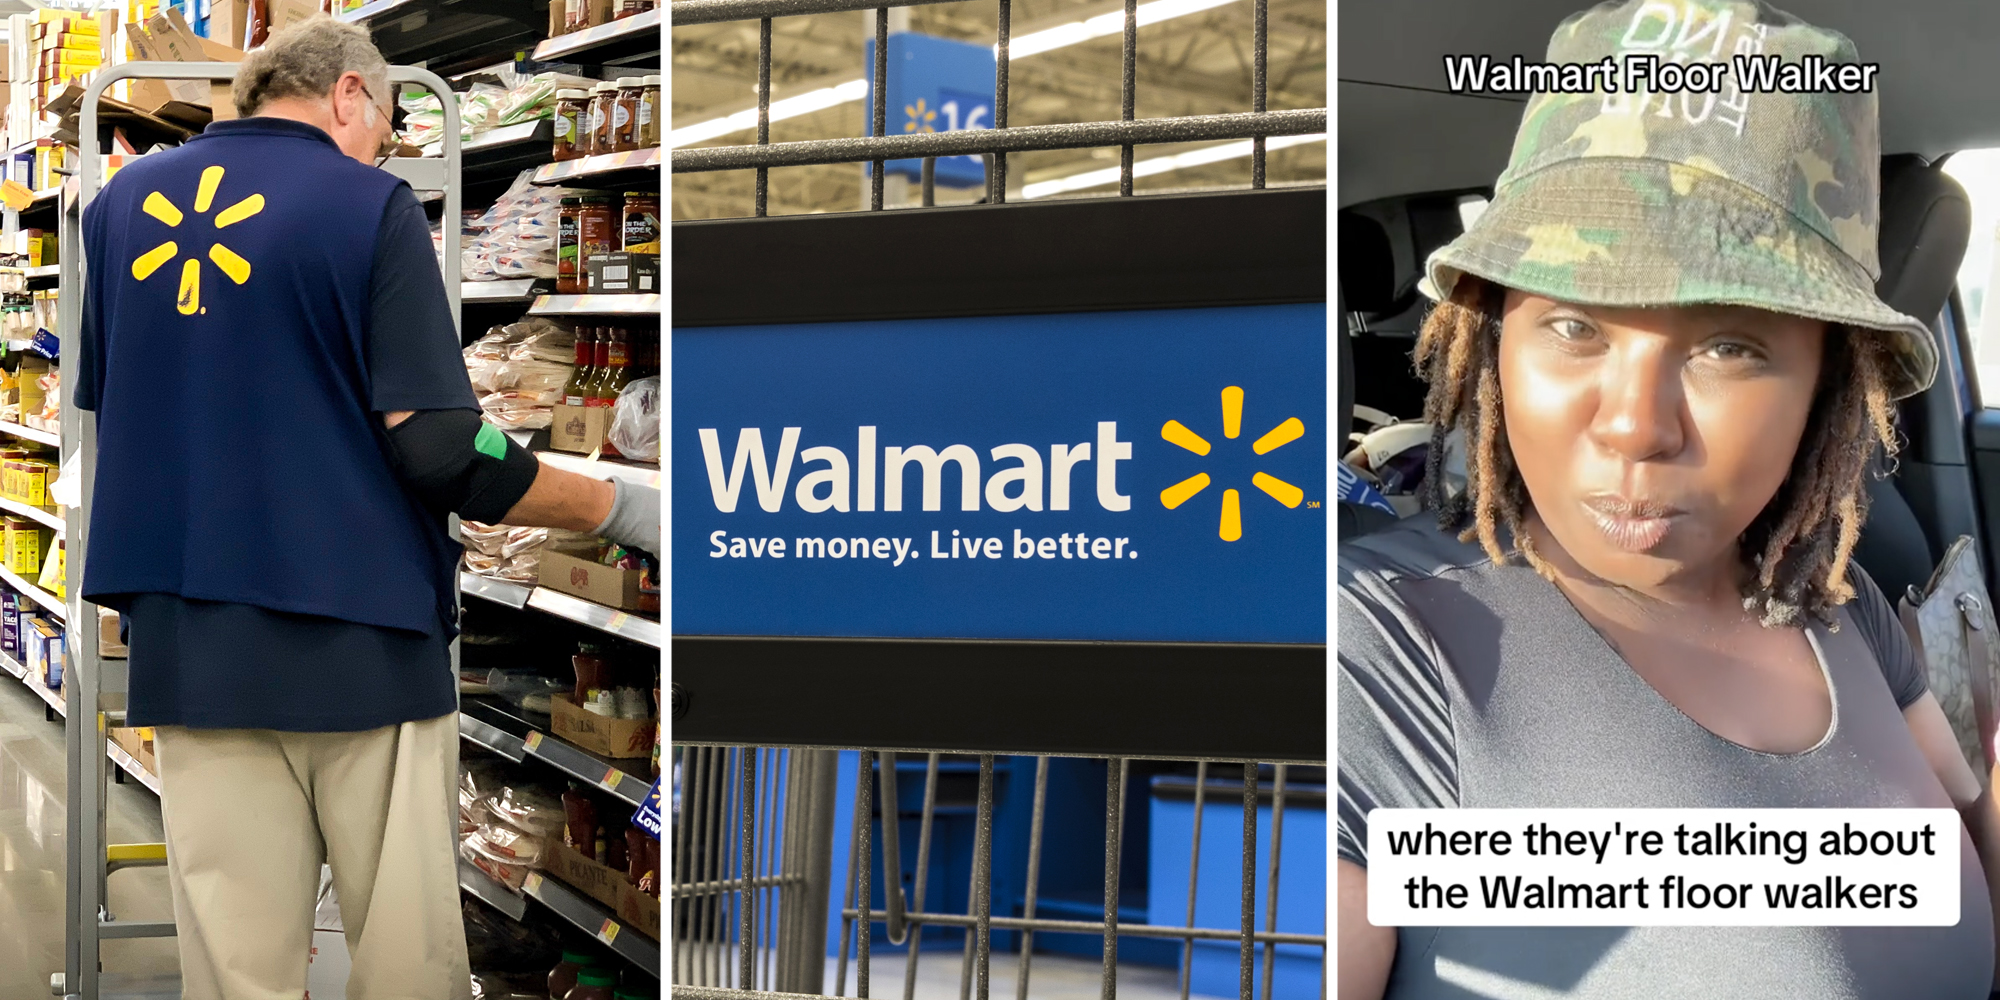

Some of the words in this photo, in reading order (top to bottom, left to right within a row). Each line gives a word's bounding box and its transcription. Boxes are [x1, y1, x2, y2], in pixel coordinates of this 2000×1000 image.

[625, 226, 652, 236] ORDER
[698, 421, 1133, 514] Walmart
[709, 530, 787, 559] Save
[795, 537, 919, 567] money.
[931, 530, 1003, 559] Live
[1013, 528, 1138, 560] better.
[636, 810, 661, 835] Low
